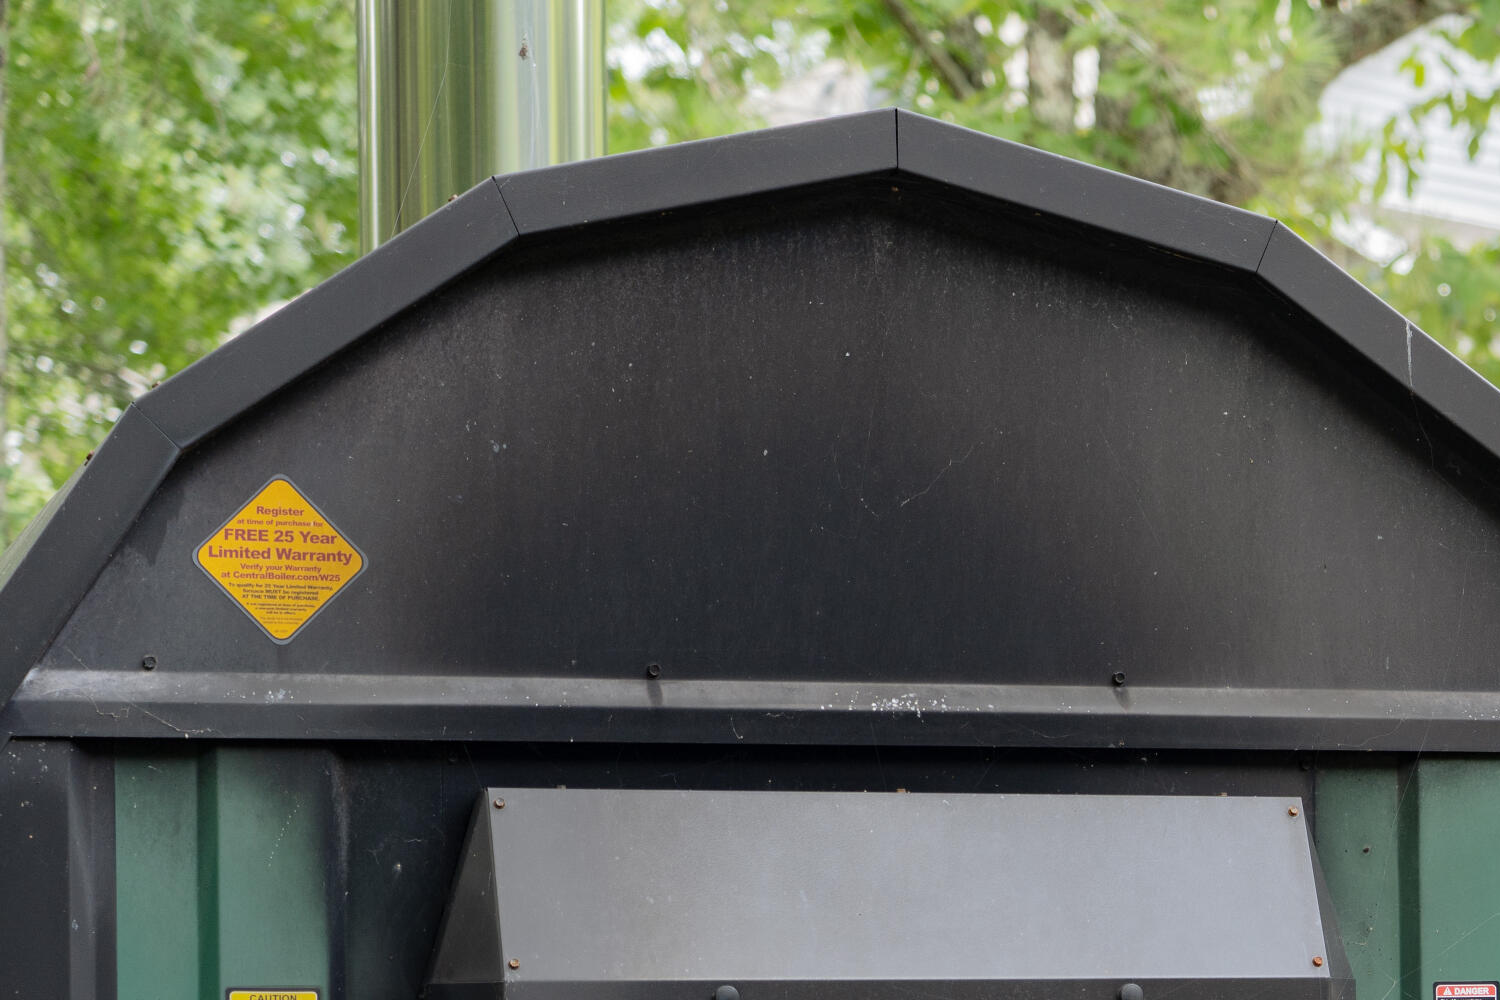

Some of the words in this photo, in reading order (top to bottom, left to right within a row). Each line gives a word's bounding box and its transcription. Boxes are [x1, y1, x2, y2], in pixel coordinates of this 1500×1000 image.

[257, 506, 304, 517] Register
[224, 528, 269, 541] FREE
[274, 530, 294, 543] 25
[299, 531, 337, 544] Year
[208, 546, 271, 560] Limited
[276, 548, 352, 565] Warranty
[240, 563, 263, 571] Verify
[284, 565, 321, 573] Warranty
[233, 571, 340, 582] CentralBoiler.com/W25
[1454, 987, 1490, 995] DANGER
